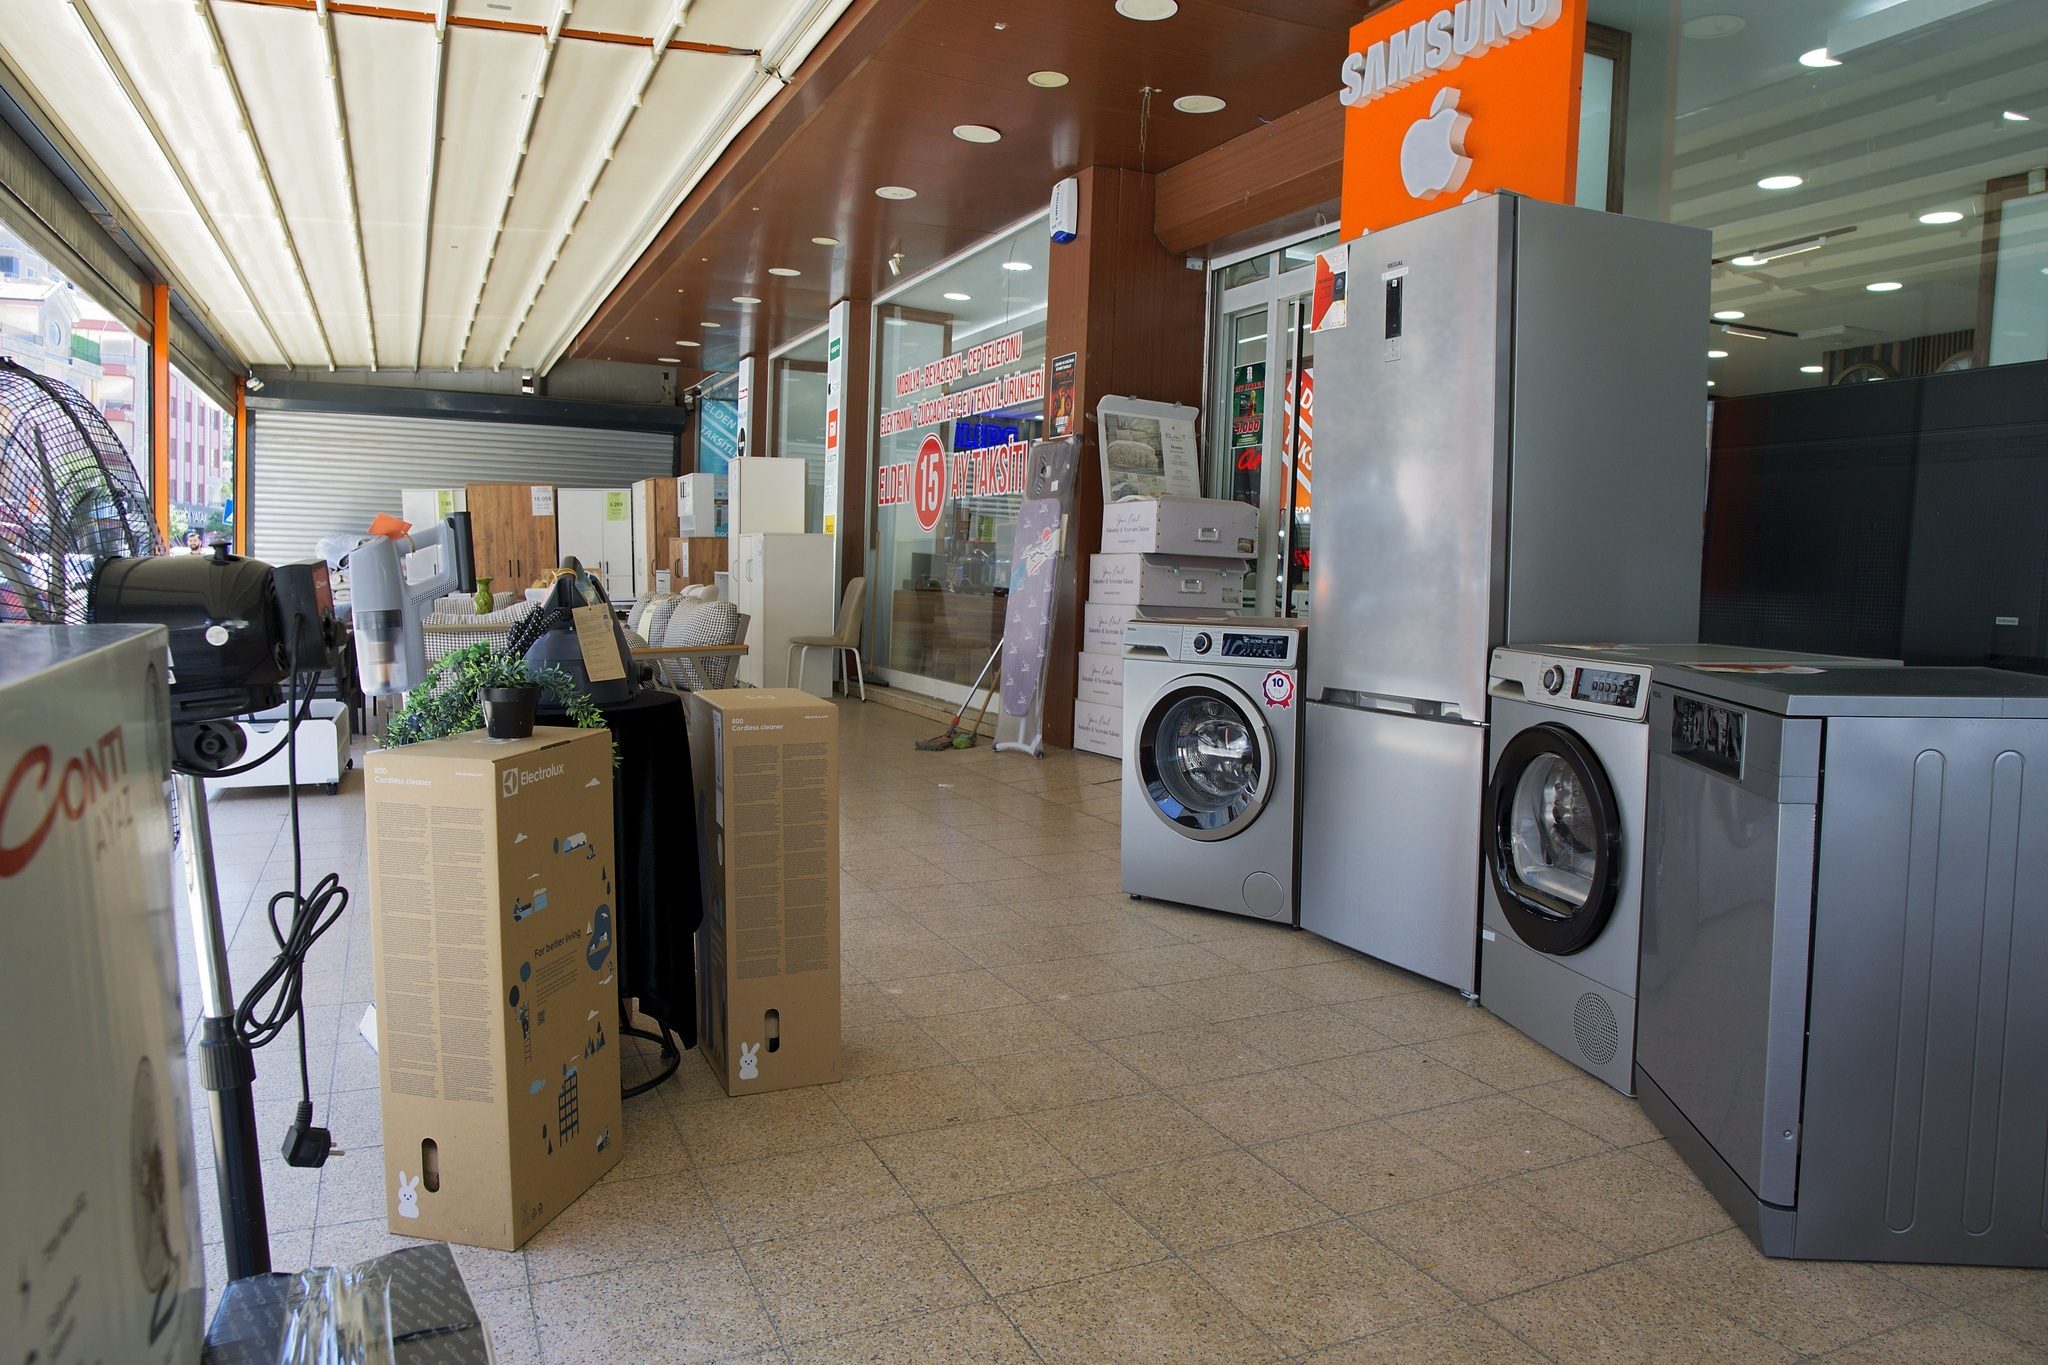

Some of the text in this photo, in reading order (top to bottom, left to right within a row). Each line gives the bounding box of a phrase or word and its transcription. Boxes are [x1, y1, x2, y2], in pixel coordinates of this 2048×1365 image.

[1387, 260, 1404, 269] REGAL
[896, 367, 920, 398] MOBİLYA
[924, 358, 944, 389] BEYAZ
[944, 352, 963, 386] EŞYA
[967, 345, 983, 376] CEP
[983, 330, 1023, 371] TELEFONU
[973, 377, 1003, 415] TEKSTİL
[1003, 363, 1045, 407] ÜRÜNLERİ
[704, 401, 737, 430] ELDEN
[878, 461, 911, 507] ELDEN
[920, 453, 939, 512] 15
[950, 450, 970, 500] AY
[1272, 677, 1284, 687] 10
[374, 776, 432, 786] Cordless cleaner
[520, 763, 565, 786] Electrolux
[534, 929, 581, 958] For better living
